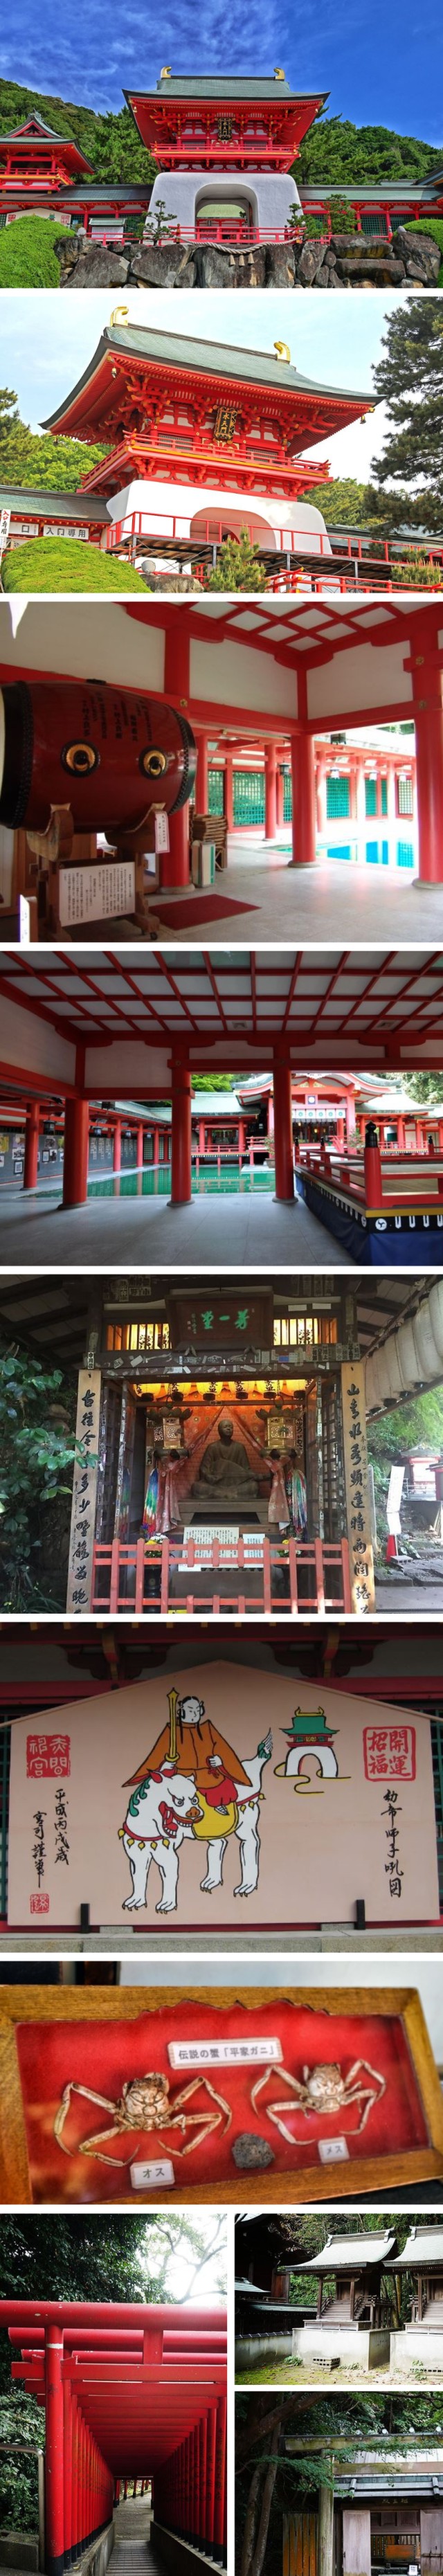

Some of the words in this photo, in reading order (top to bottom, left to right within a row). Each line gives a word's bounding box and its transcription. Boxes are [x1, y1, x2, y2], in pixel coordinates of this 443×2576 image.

[221, 413, 230, 434] 水天門
[1, 510, 10, 534] 入口専用
[46, 527, 86, 538] 入口専用
[54, 1788, 70, 1866] 平成丙戌歳
[179, 2044, 275, 2060] 伝説の蟹「平家ガニ」
[327, 2145, 343, 2156] メス
[143, 2168, 165, 2179] オス
